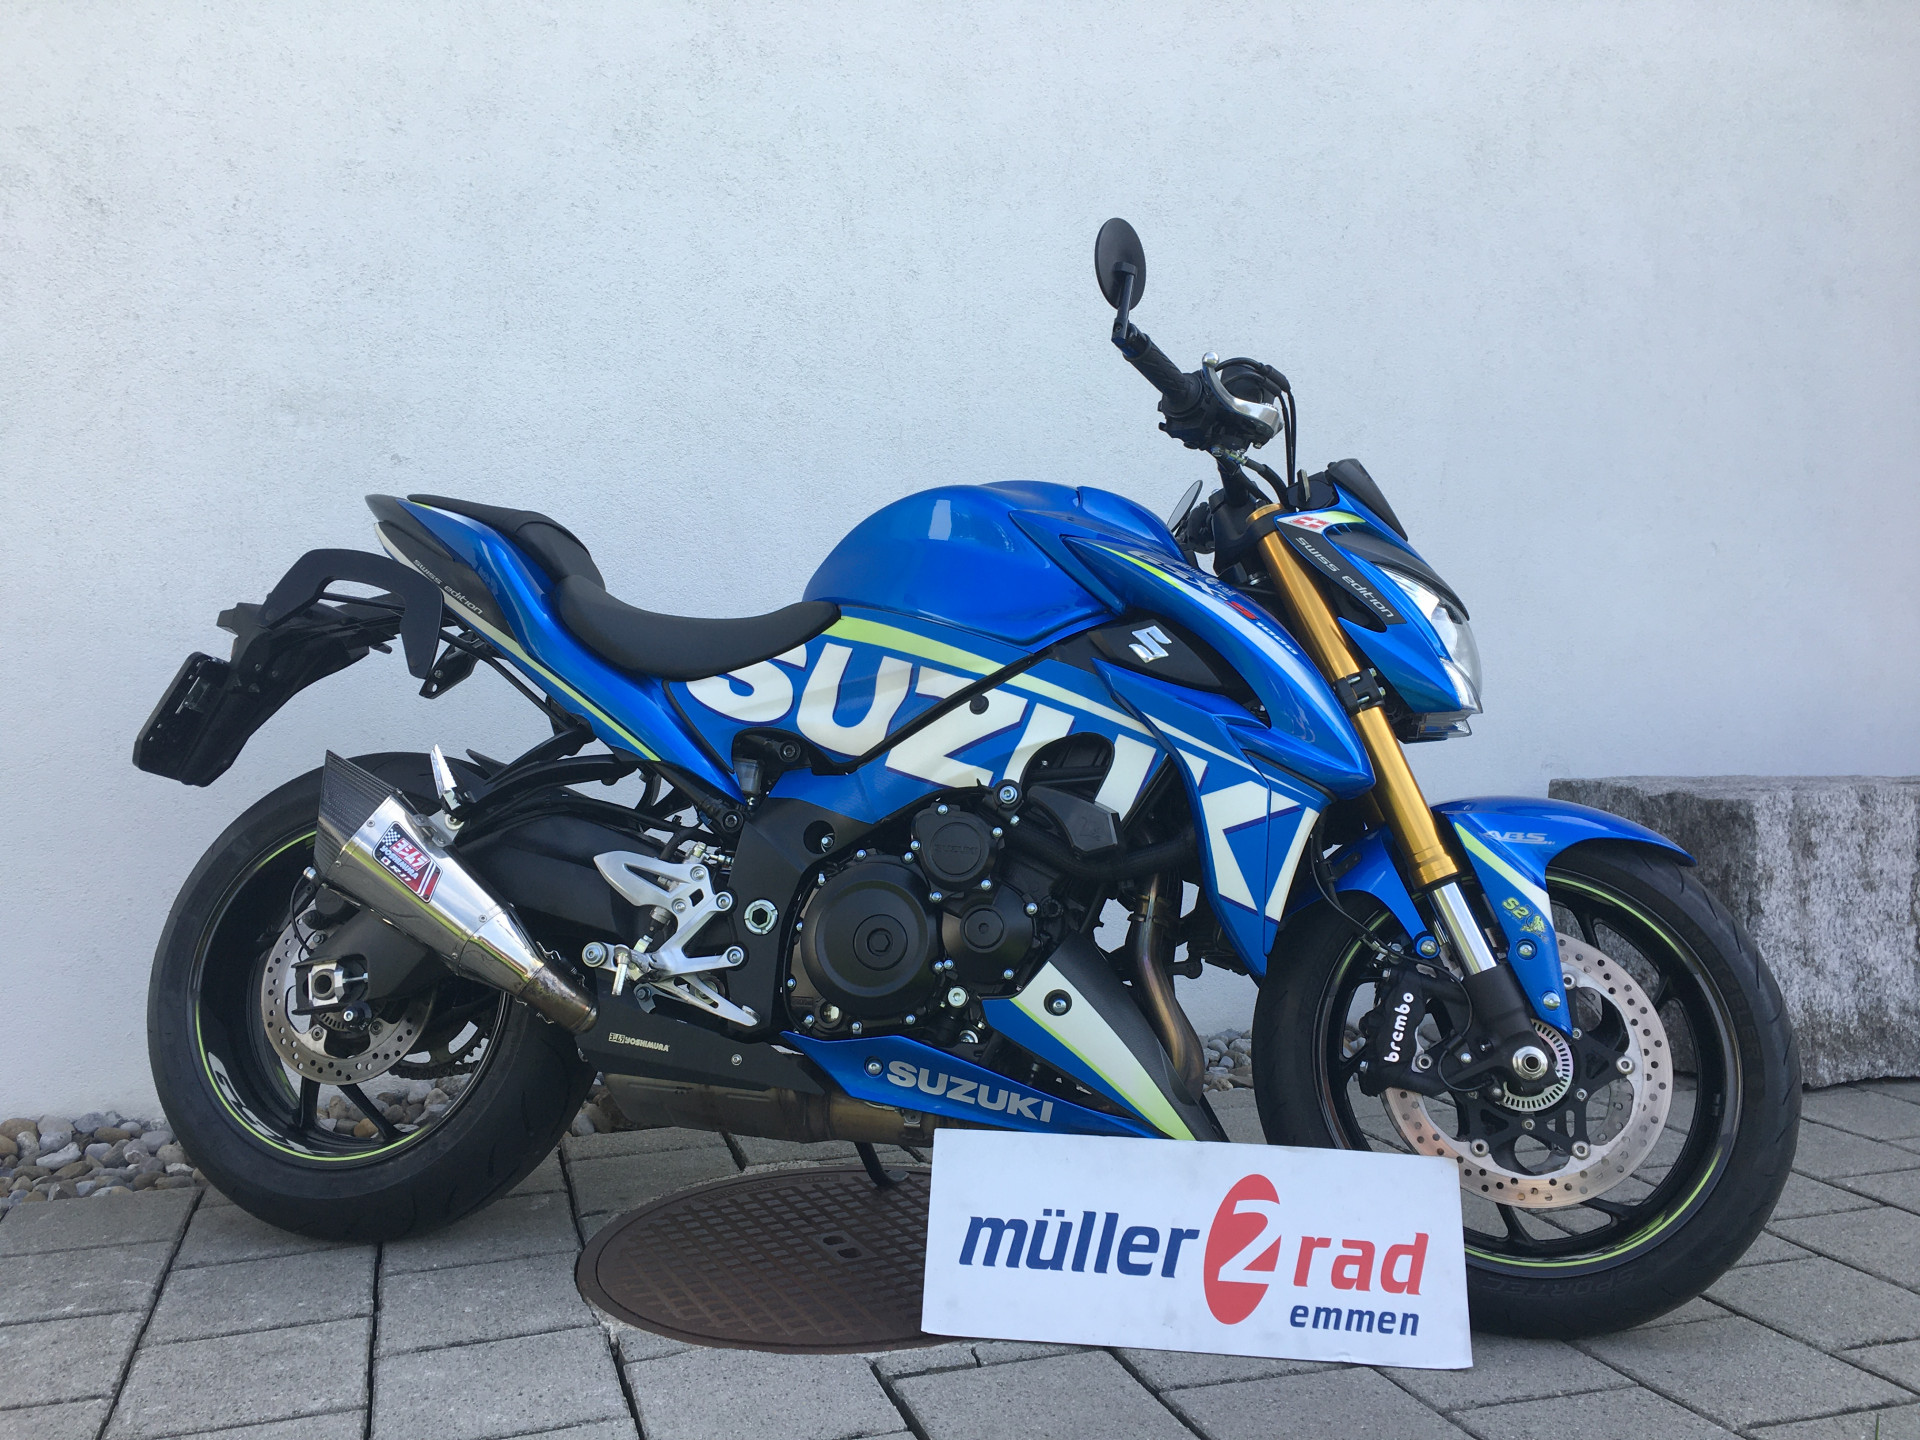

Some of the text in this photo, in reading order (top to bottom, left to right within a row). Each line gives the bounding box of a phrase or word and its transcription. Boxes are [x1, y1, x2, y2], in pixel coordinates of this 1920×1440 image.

[412, 559, 483, 615] swiss edition
[1295, 536, 1394, 618] swiss edition
[379, 844, 419, 880] YOSHIMURA
[1482, 830, 1549, 845] ABS
[624, 1036, 669, 1052] YOSHIMURA
[1384, 992, 1414, 1063] brembo
[886, 1060, 1054, 1123] SUZUKI
[958, 1208, 1199, 1279] müller
[1293, 1232, 1430, 1296] rad
[1289, 1304, 1420, 1337] emmen
